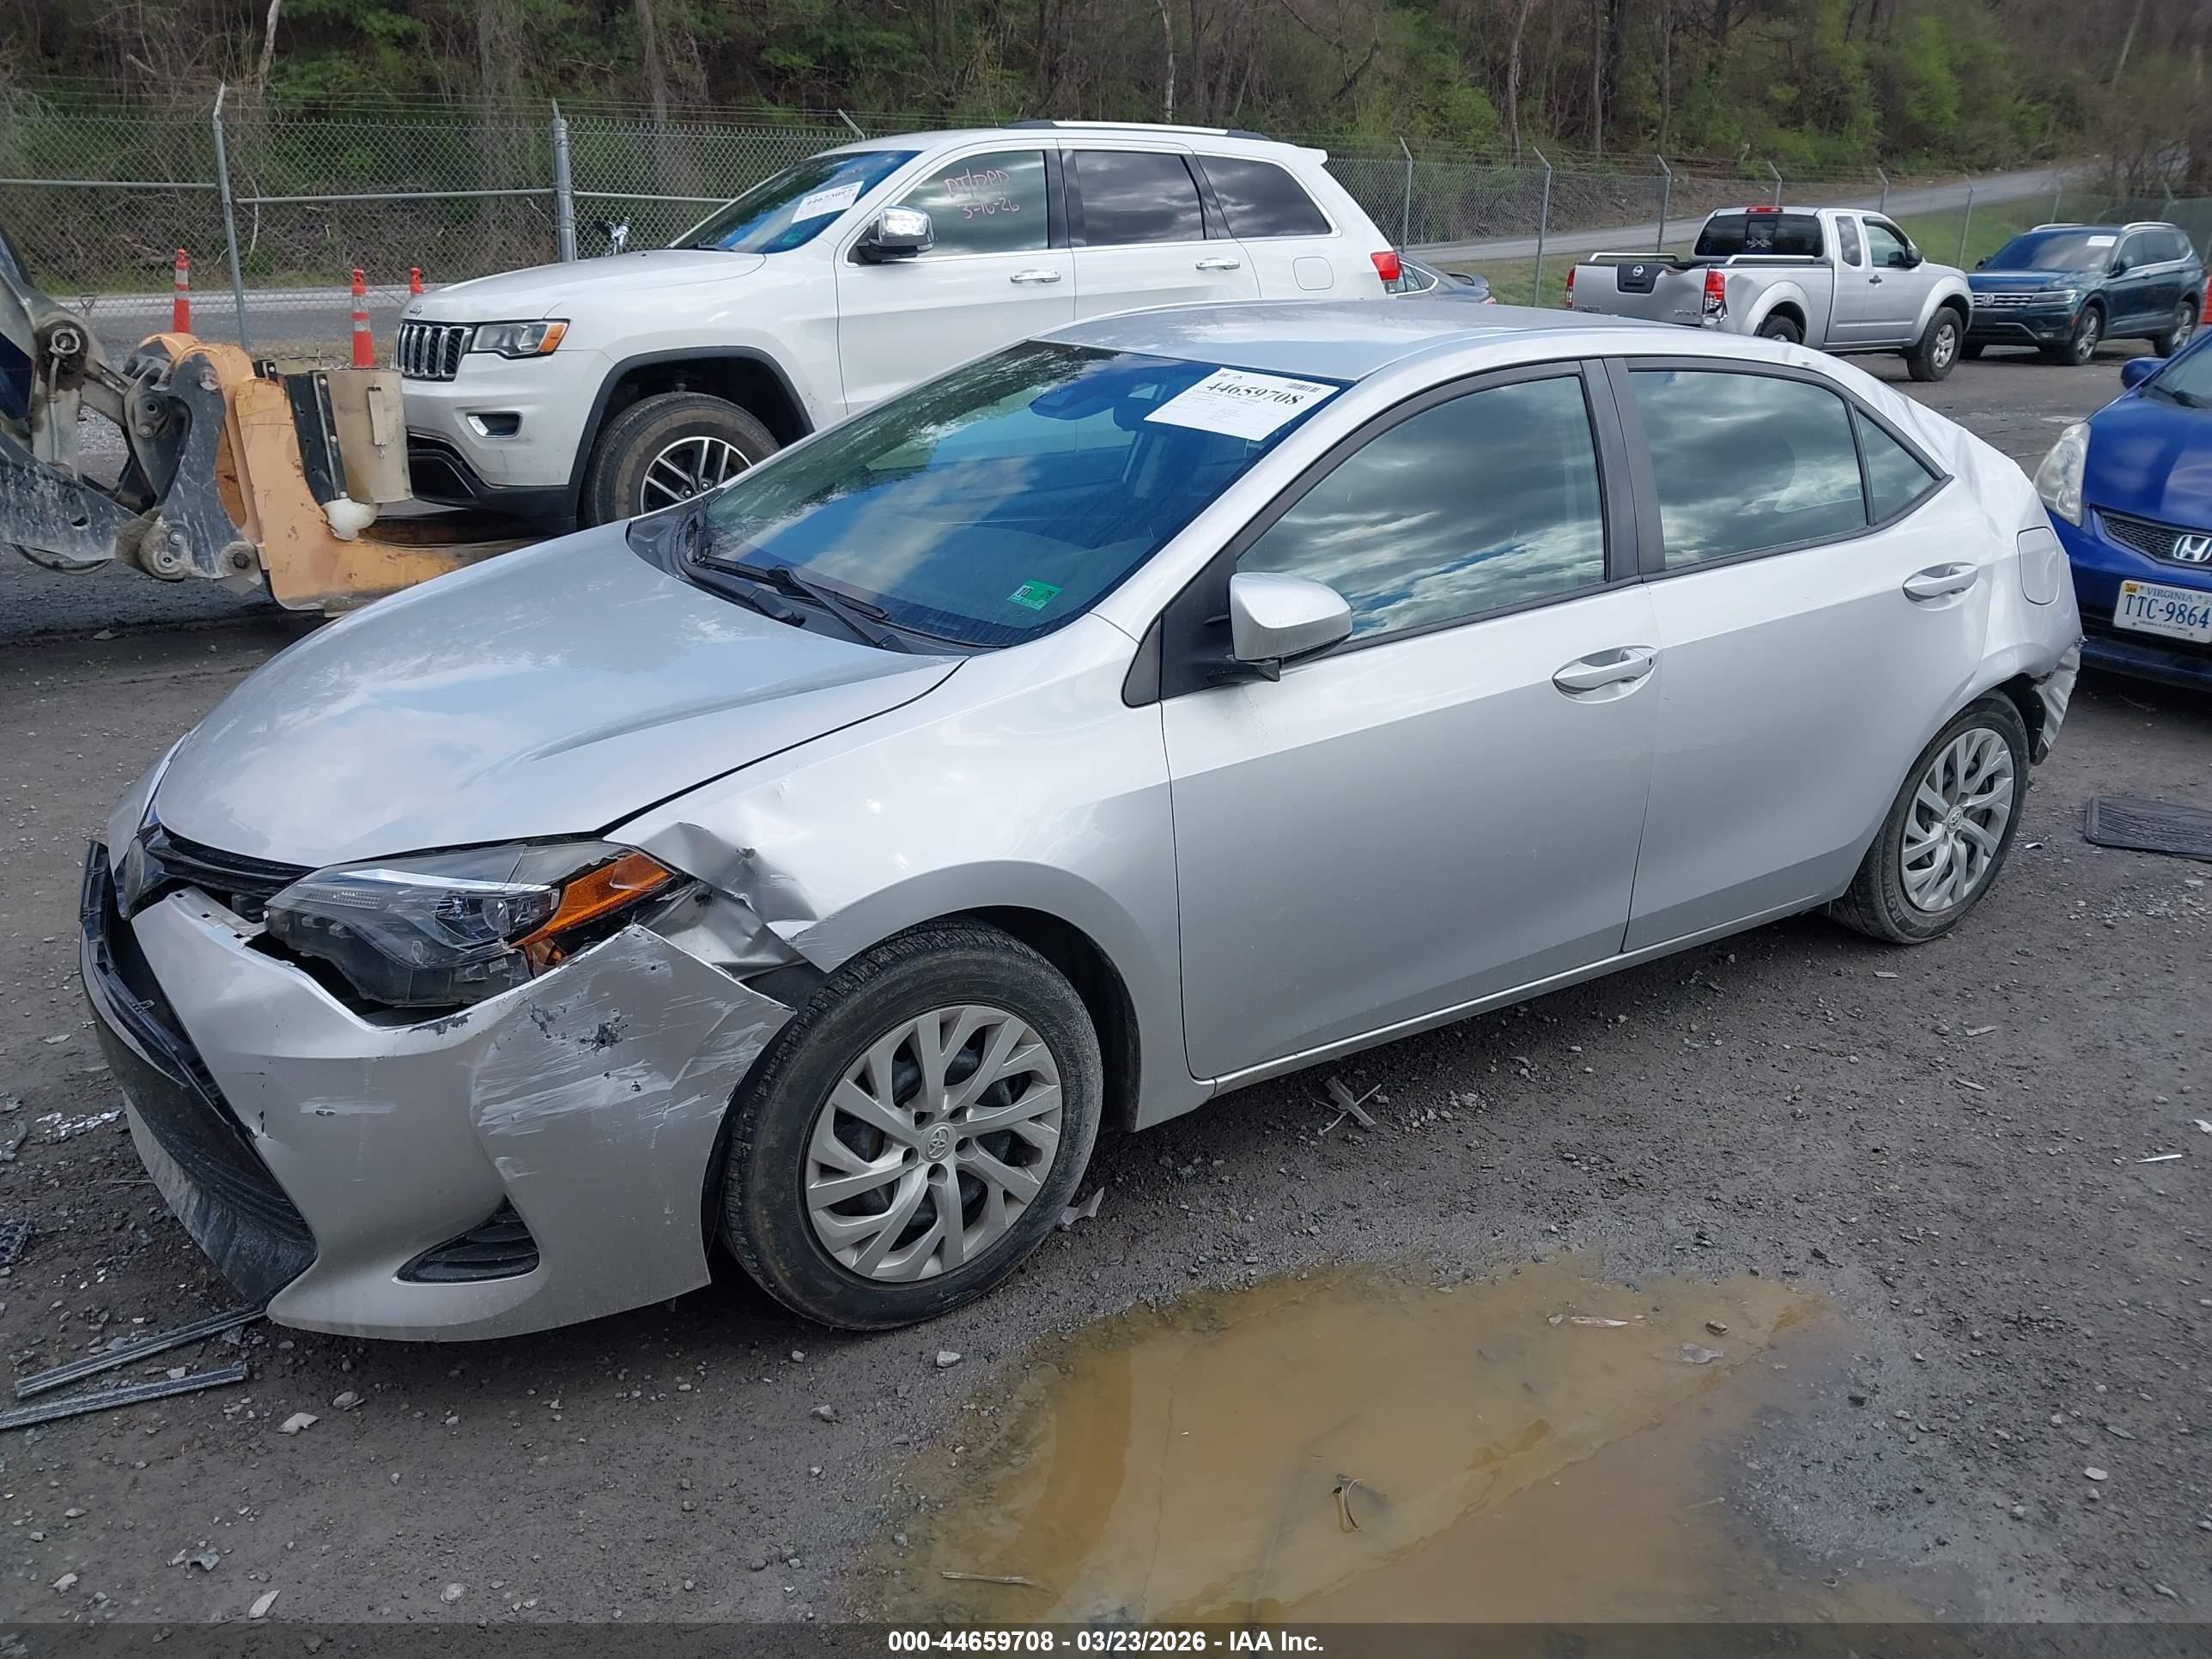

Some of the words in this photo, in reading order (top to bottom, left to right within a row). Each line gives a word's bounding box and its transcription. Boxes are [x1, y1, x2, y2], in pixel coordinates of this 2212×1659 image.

[960, 198, 1020, 220] 3-16-26
[1206, 382, 1305, 405] 44659708
[2147, 587, 2193, 602] VIRGINIA
[2124, 593, 2211, 629] TTC-9864
